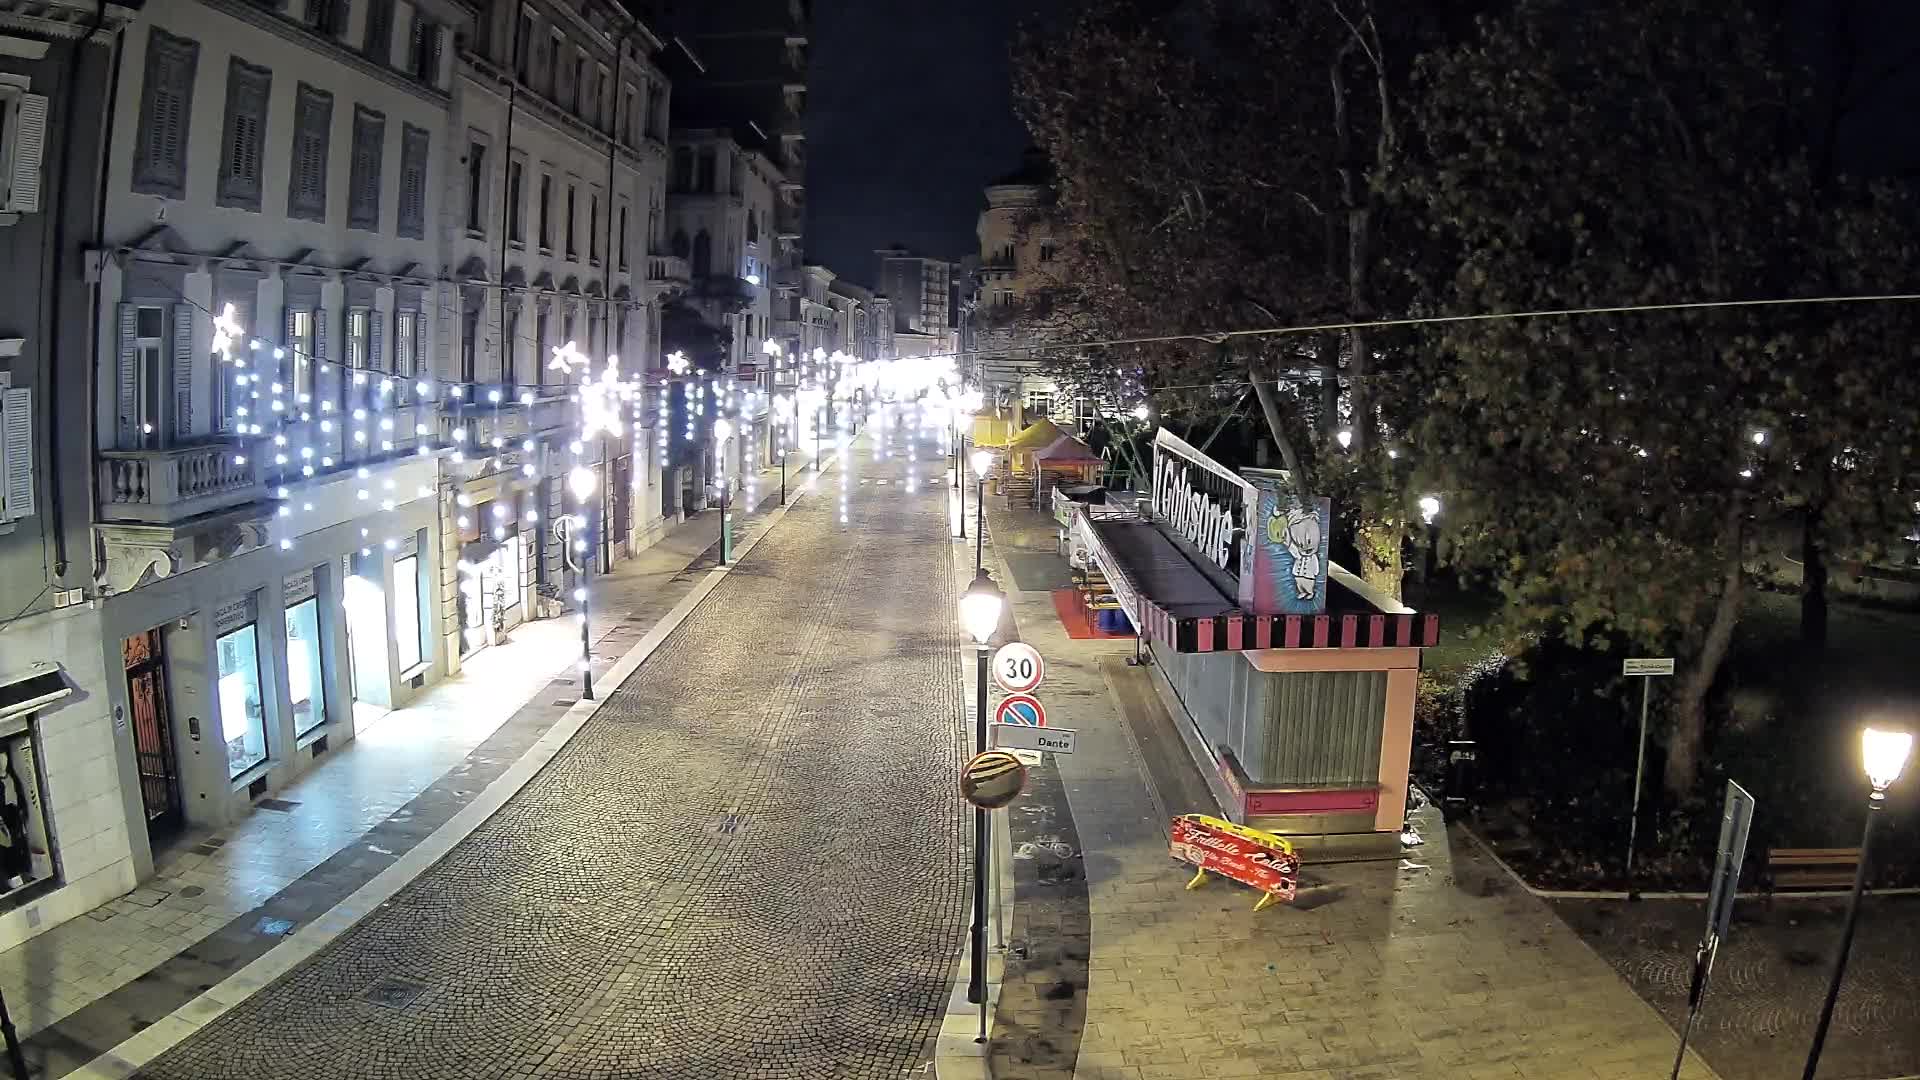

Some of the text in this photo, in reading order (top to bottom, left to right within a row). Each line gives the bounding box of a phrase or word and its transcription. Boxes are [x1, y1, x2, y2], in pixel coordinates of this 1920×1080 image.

[1163, 458, 1233, 569] Golosone
[1006, 658, 1032, 679] 30
[1038, 737, 1070, 749] Dante
